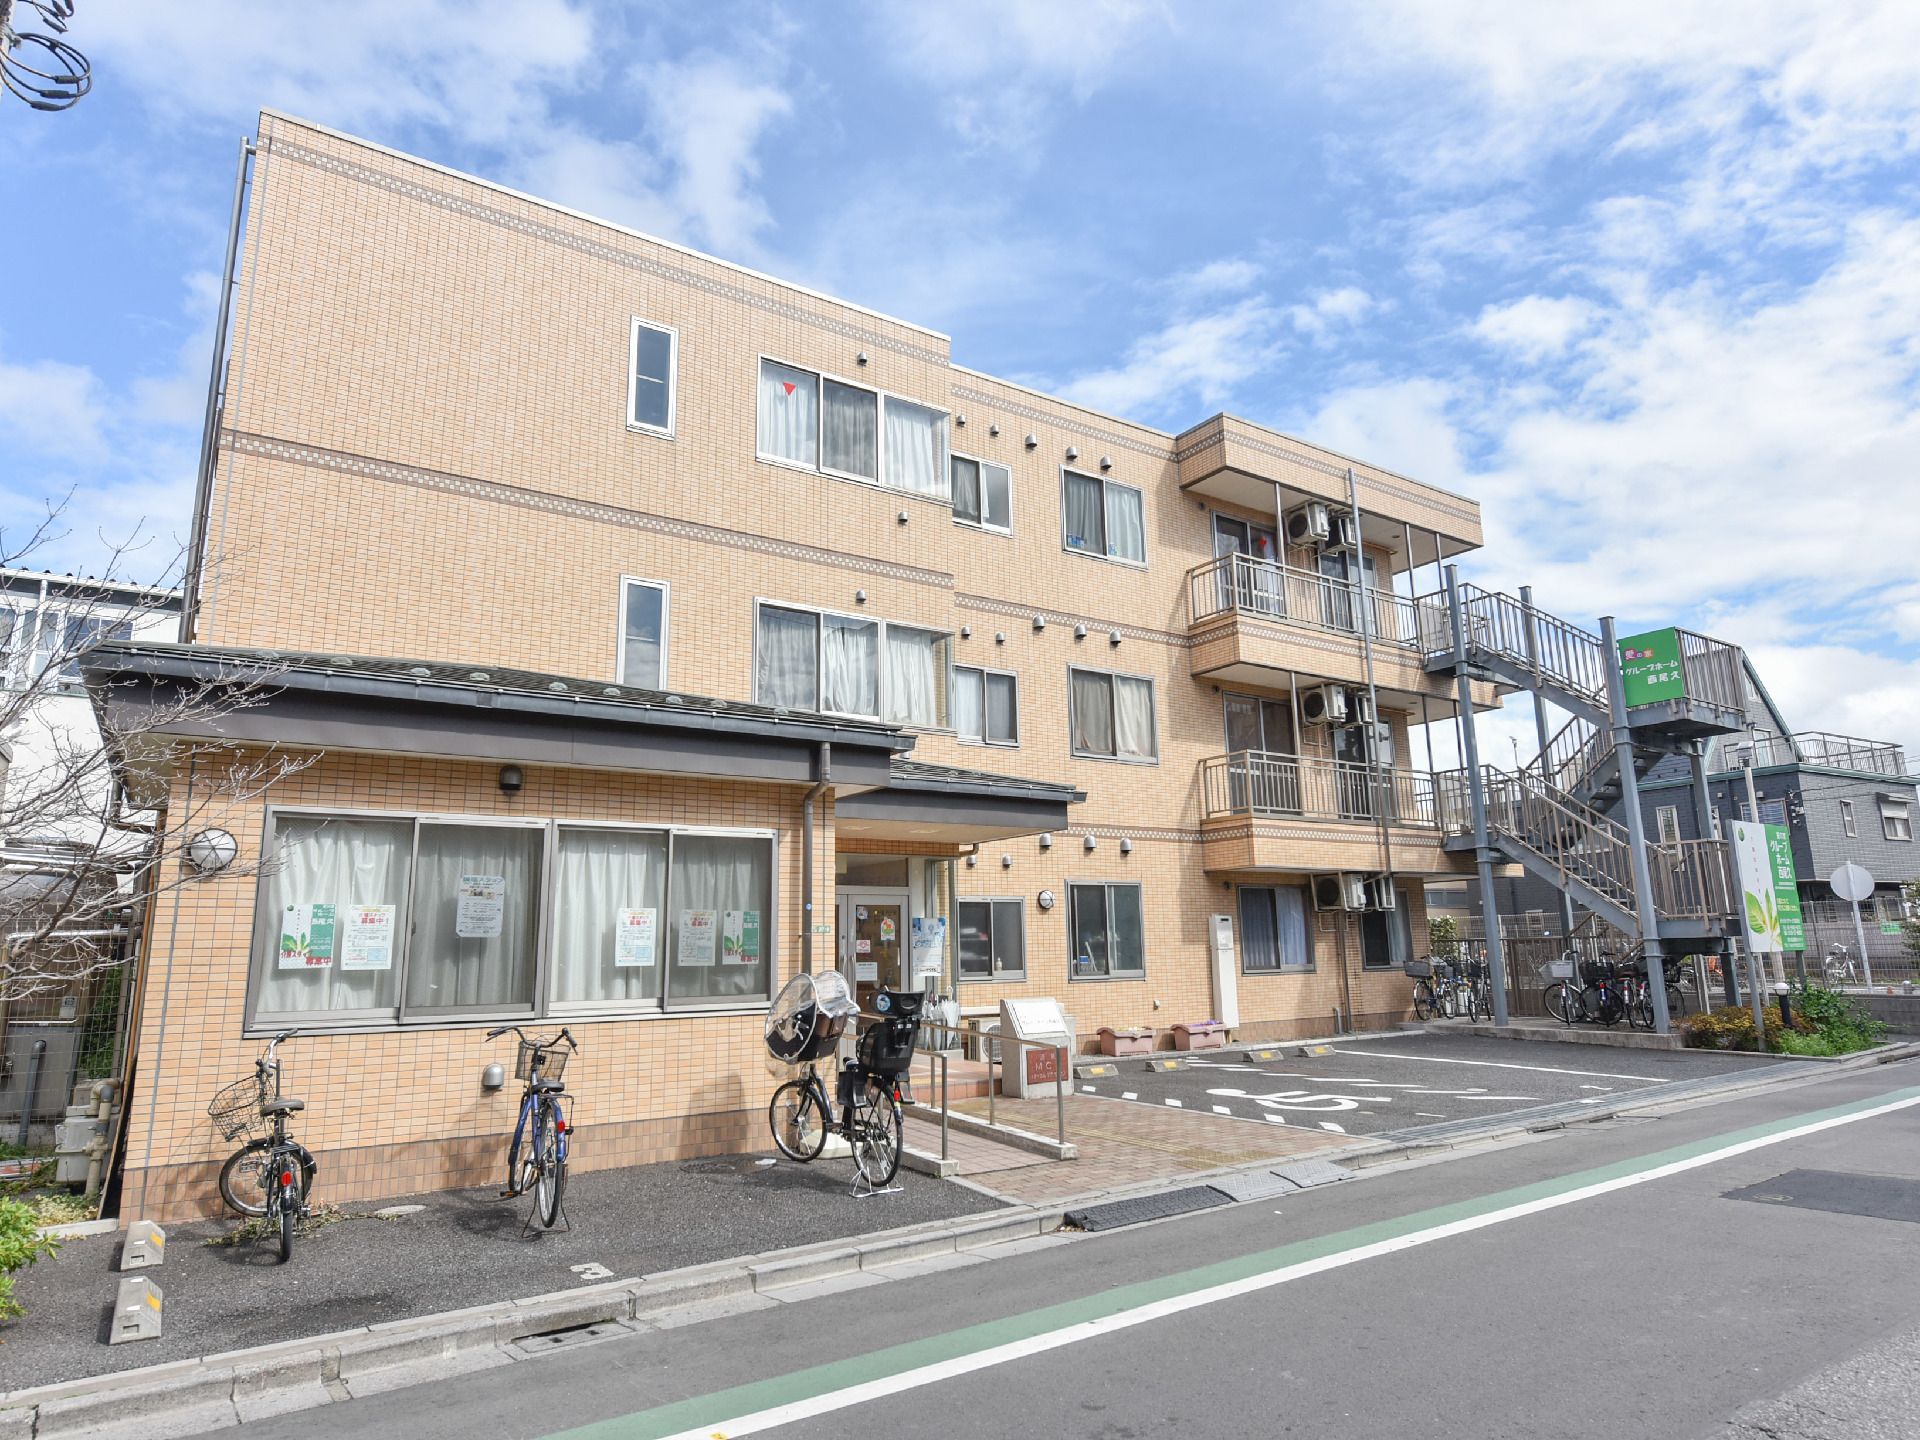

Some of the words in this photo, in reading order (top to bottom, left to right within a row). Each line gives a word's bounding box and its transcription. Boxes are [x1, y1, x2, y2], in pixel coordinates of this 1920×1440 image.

[1626, 660, 1679, 676] グループホーム
[1647, 671, 1680, 685] 西尾久
